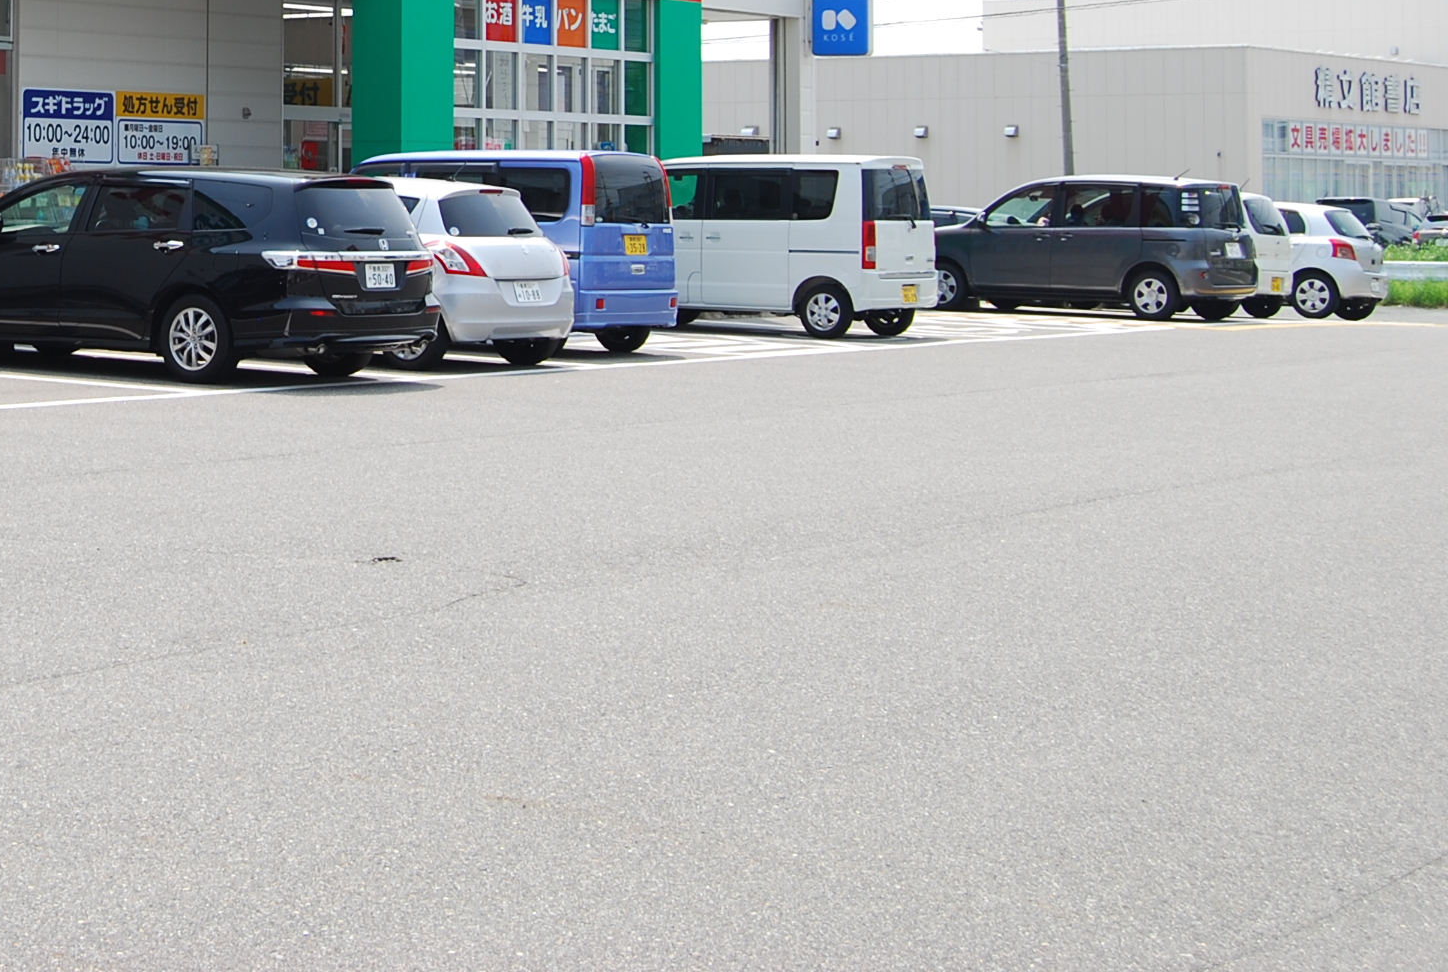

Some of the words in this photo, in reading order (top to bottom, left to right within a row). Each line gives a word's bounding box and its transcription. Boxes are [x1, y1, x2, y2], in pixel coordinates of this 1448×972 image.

[486, 1, 513, 26] お酒
[522, 4, 548, 29] 牛乳
[557, 7, 582, 31] パン
[823, 32, 854, 41] KOSÉ
[1314, 66, 1422, 115] 精文館書店
[31, 95, 108, 116] スギドラッグ
[122, 95, 198, 116] 処方せん受付
[52, 147, 85, 158] 年中無休
